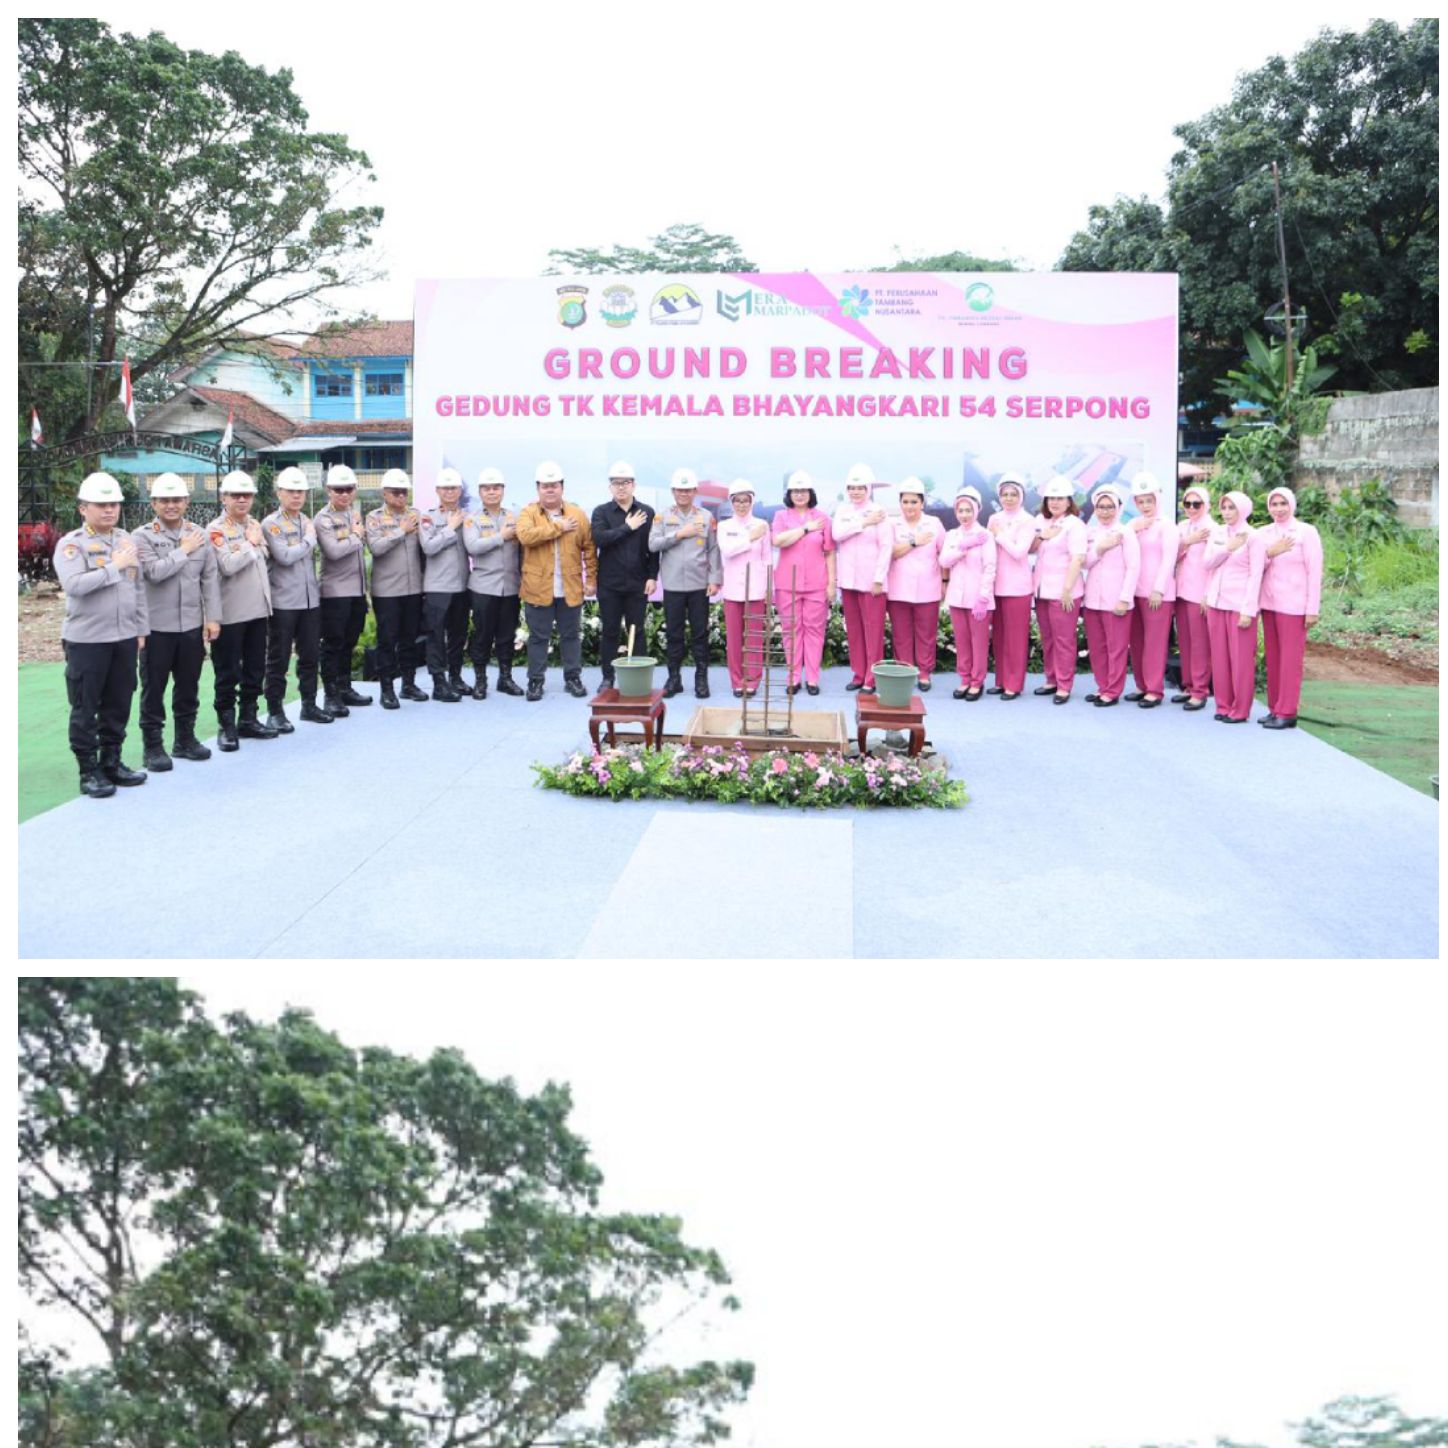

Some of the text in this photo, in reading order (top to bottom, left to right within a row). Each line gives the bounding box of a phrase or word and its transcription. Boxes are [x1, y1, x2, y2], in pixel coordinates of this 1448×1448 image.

[543, 347, 1029, 381] GROUND BREAKING
[435, 395, 1151, 420] GEDUNG TK KEMALA BHAYANGKARI 54 SERPONG
